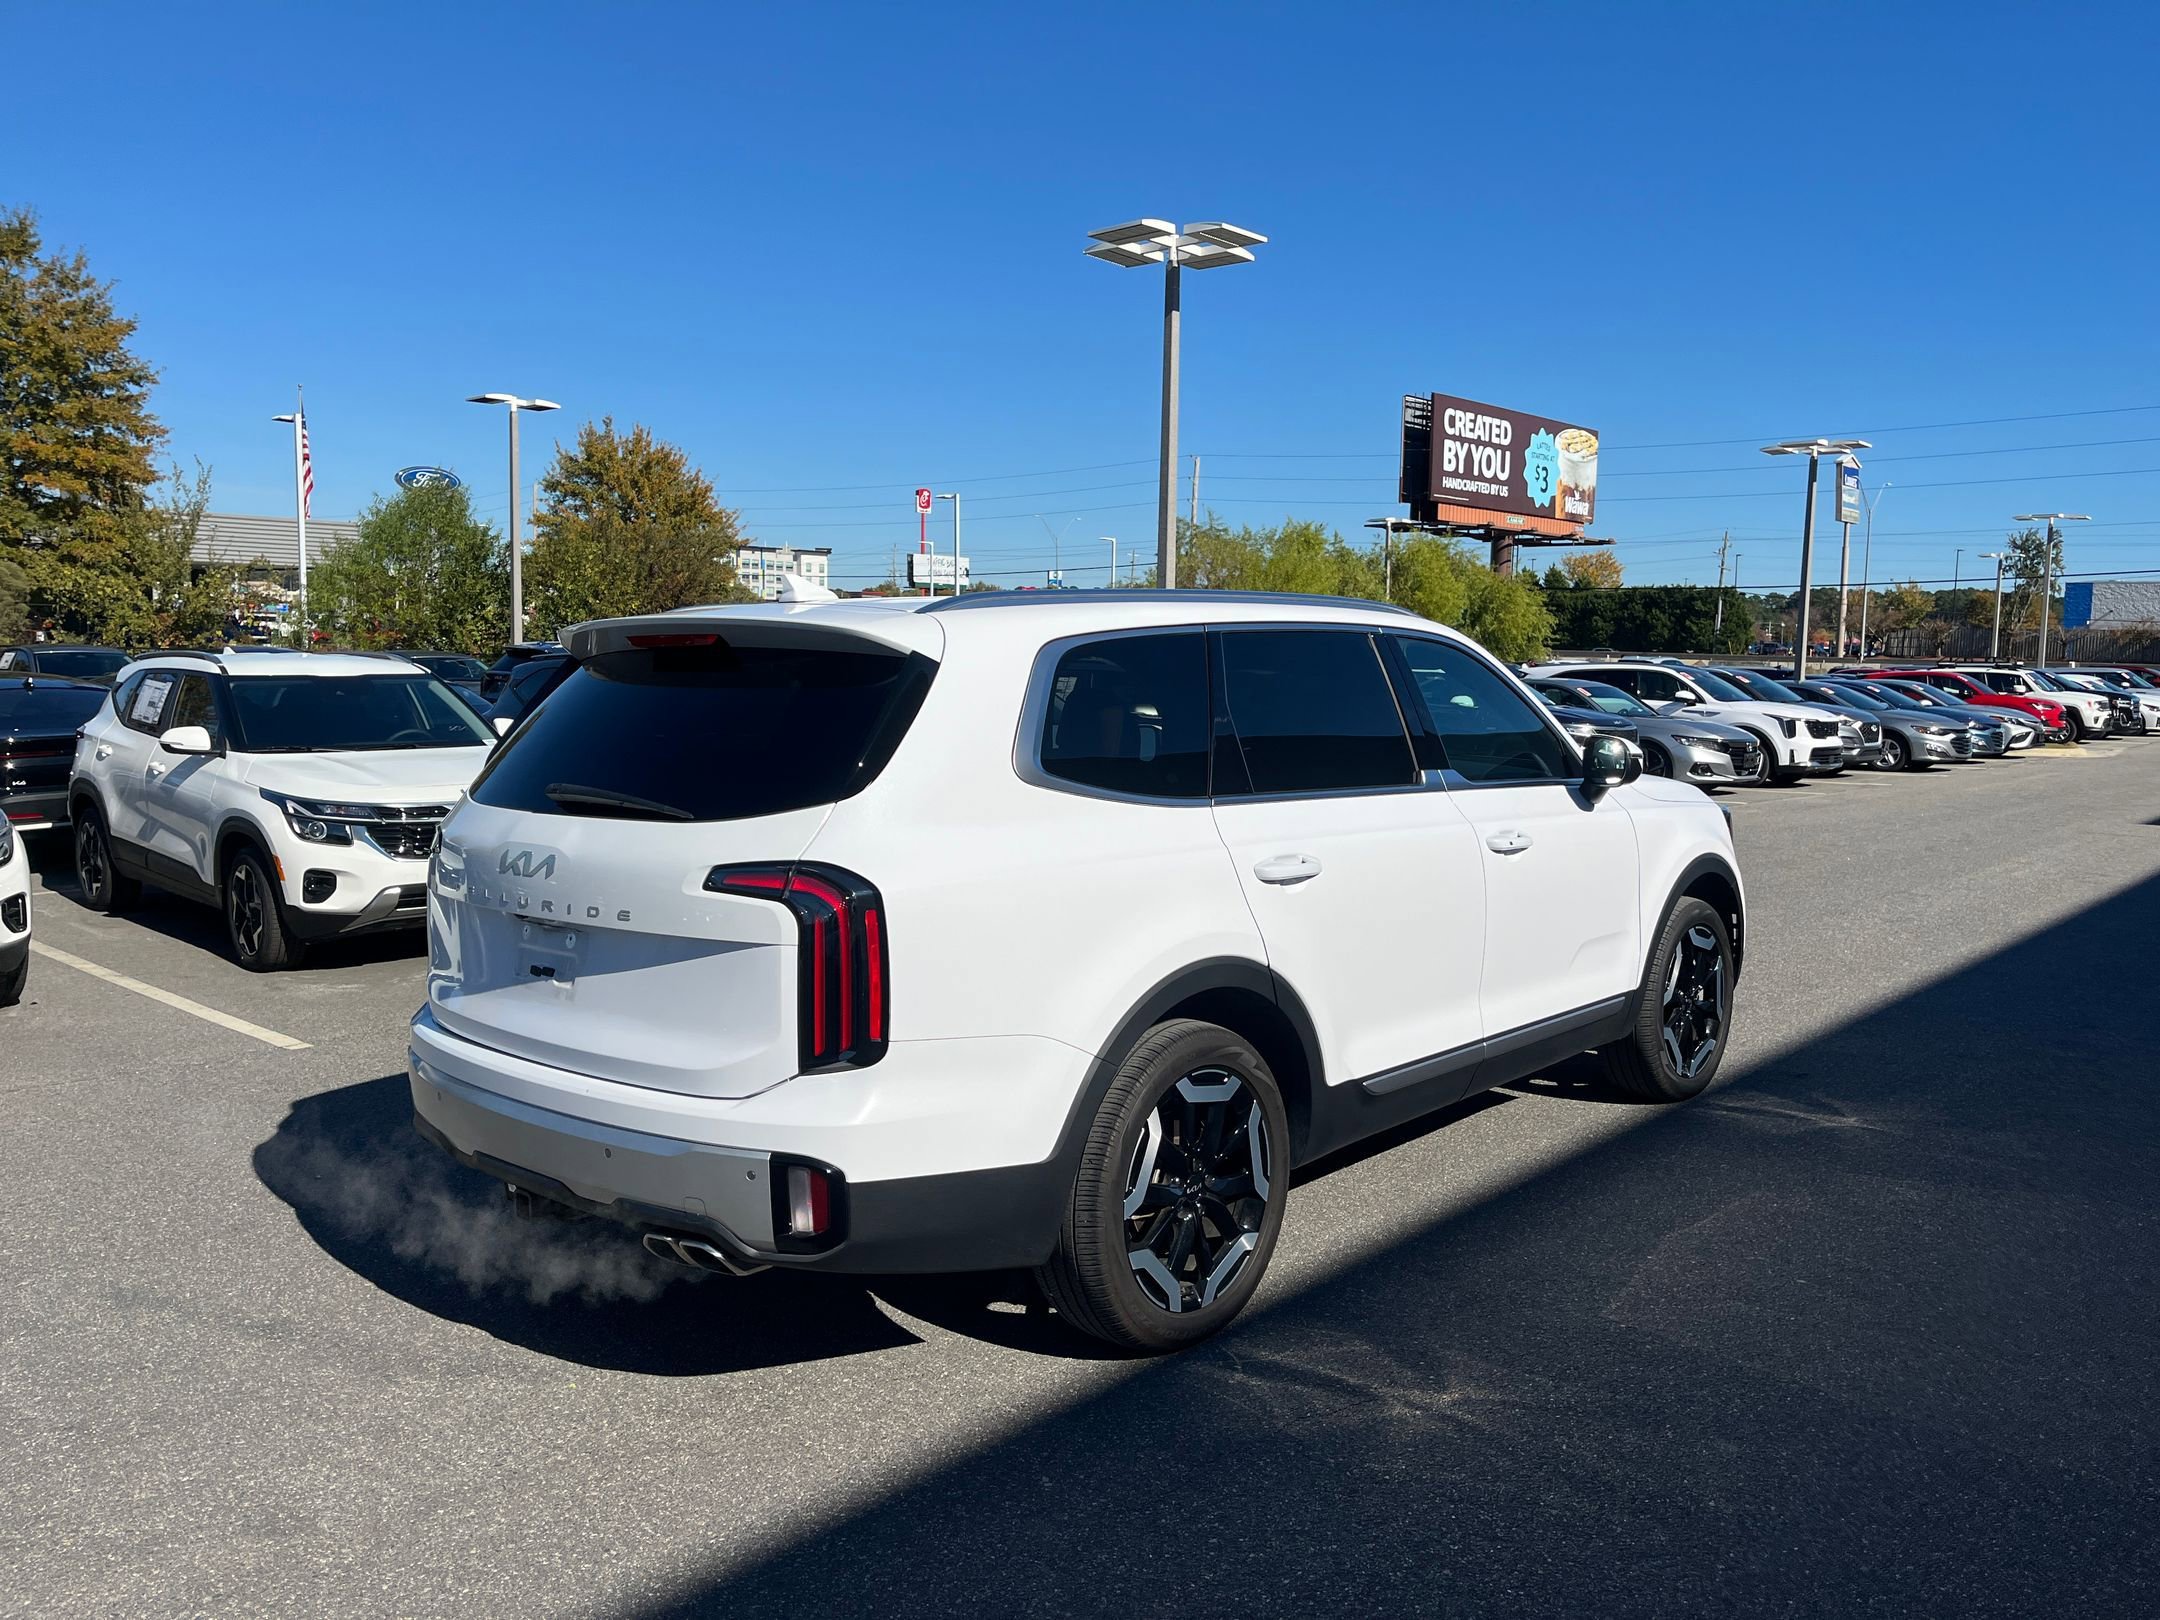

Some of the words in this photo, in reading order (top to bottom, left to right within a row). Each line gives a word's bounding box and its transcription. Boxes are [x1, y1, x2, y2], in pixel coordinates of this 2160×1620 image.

[1443, 408, 1512, 446] CREATED
[1443, 439, 1469, 474] BY
[1470, 443, 1511, 481] YOU
[1442, 476, 1490, 494] HANDCRAFTED
[1490, 483, 1499, 496] BY
[1499, 485, 1509, 498] US
[1535, 463, 1549, 494] $3
[1564, 495, 1589, 515] Wawa
[499, 848, 556, 880] KIA
[469, 886, 631, 922] LLURIDE
